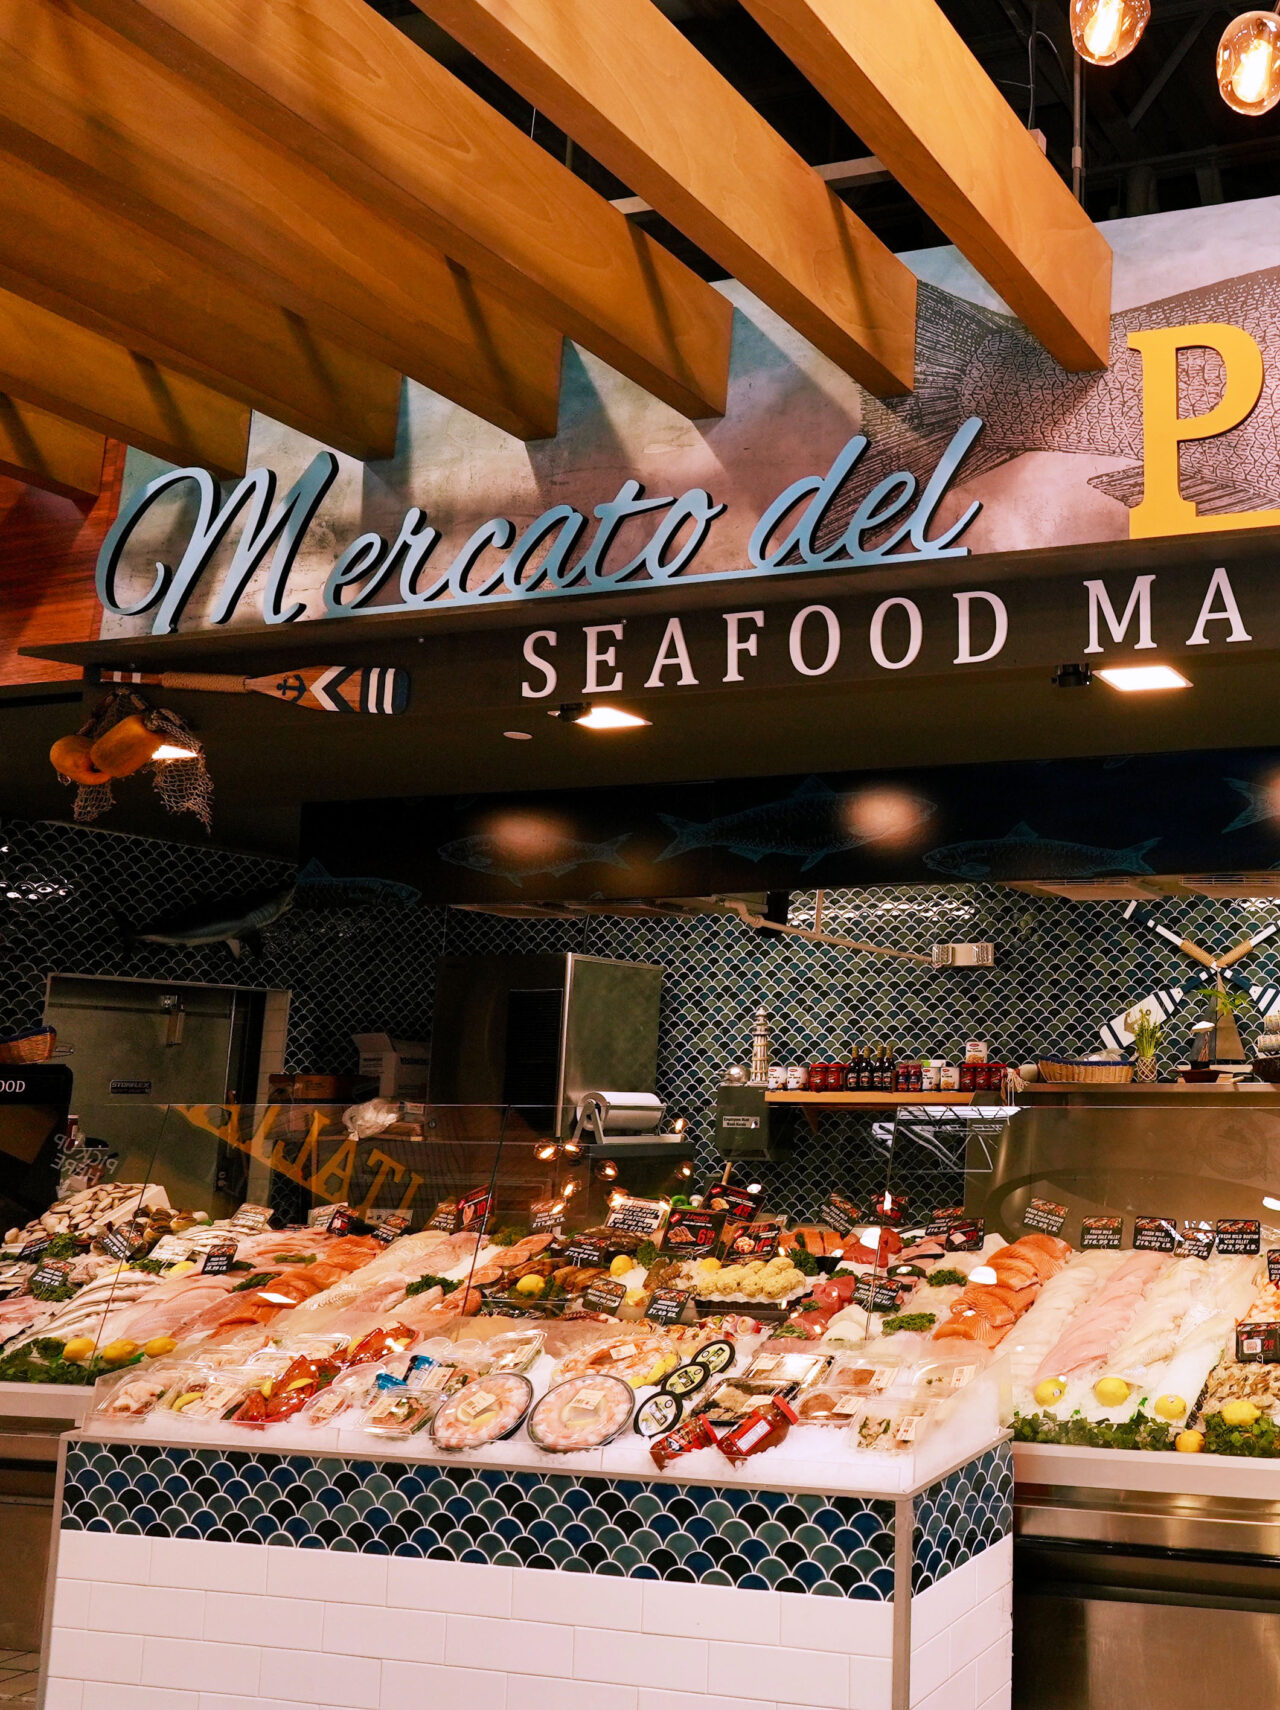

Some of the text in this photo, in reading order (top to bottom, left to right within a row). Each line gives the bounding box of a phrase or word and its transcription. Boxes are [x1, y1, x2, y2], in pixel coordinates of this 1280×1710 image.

[94, 417, 982, 635] Mercato del
[521, 590, 1009, 698] SEAFOOD
